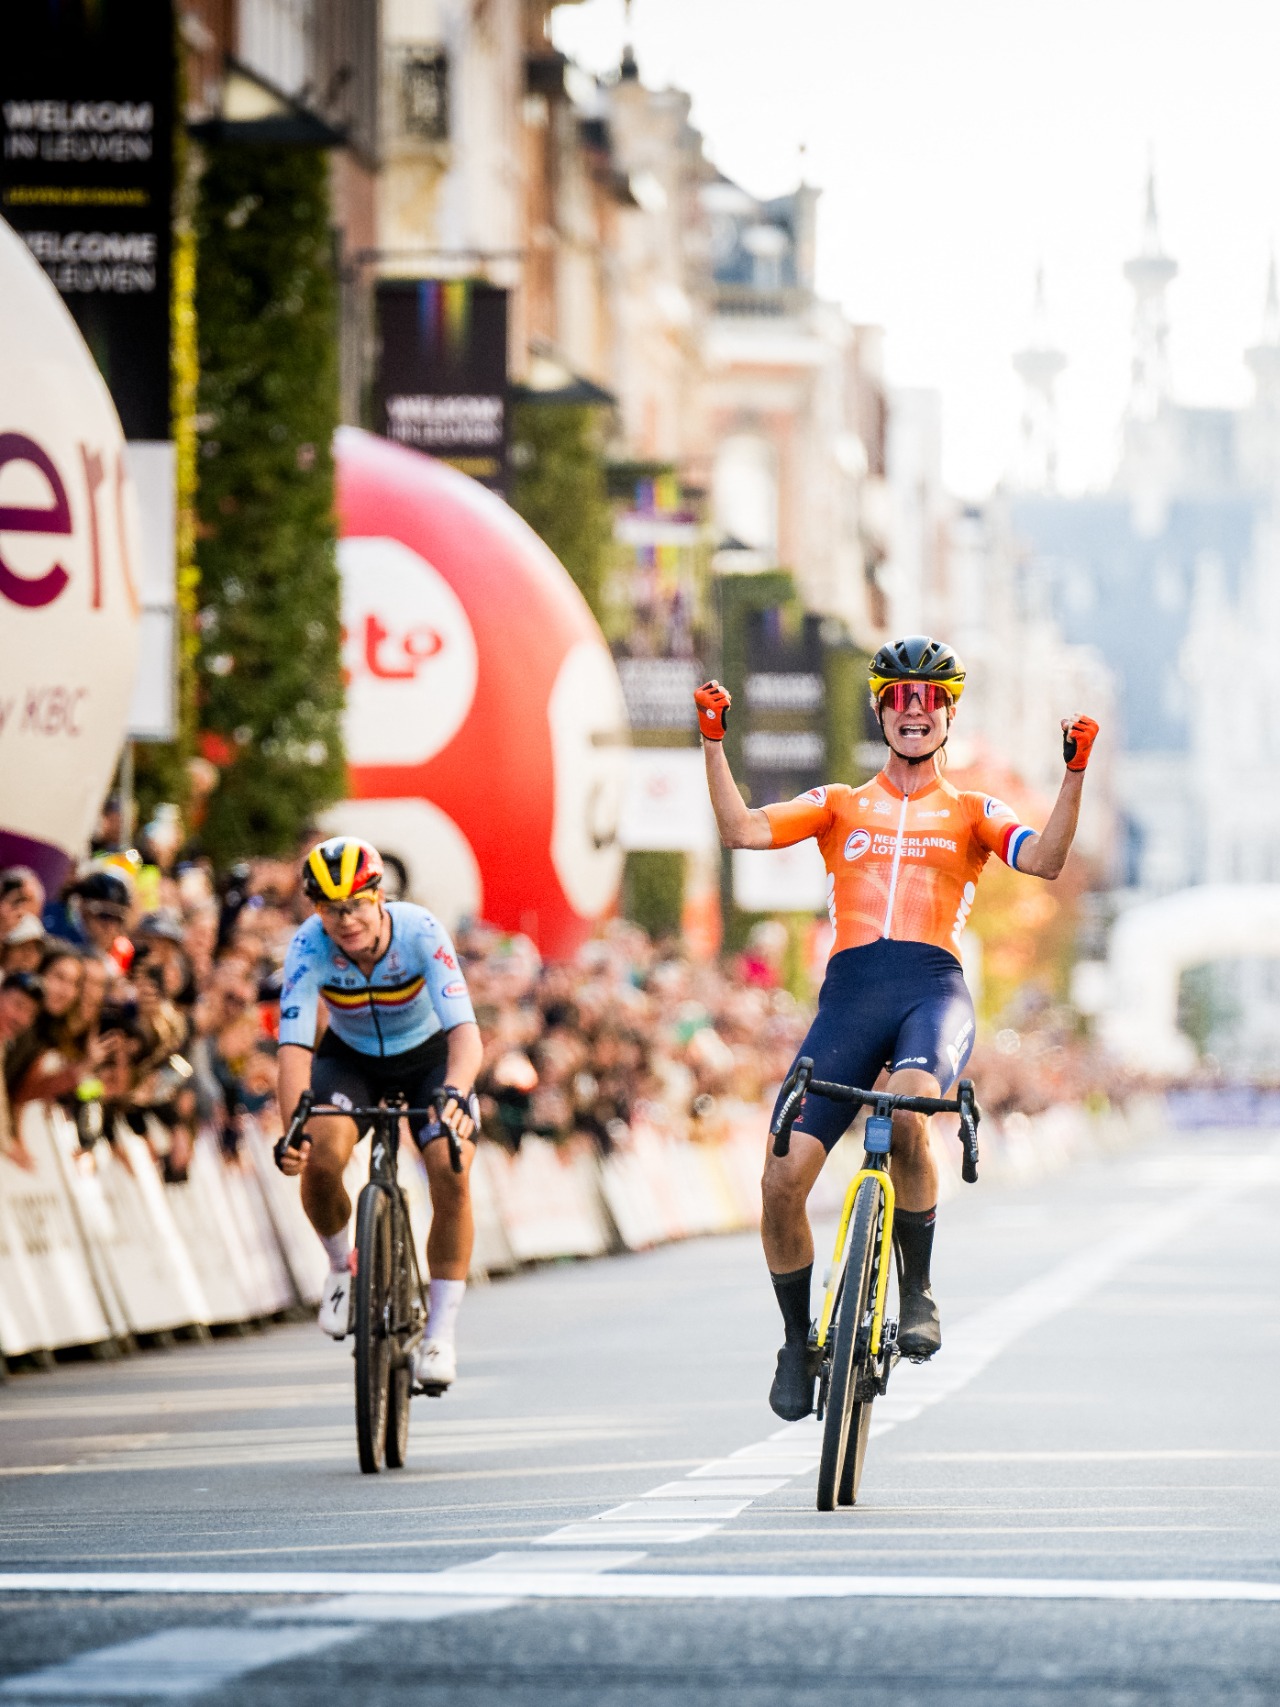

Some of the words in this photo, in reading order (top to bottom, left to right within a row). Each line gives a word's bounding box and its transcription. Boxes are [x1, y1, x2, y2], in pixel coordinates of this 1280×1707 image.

[2, 101, 153, 131] WELKOM
[41, 132, 153, 163] LEUVEN
[20, 231, 157, 262] ELCOME
[21, 686, 90, 736] KBC
[871, 844, 926, 858] LOTERIJ
[873, 833, 957, 853] NEDERLANDSE
